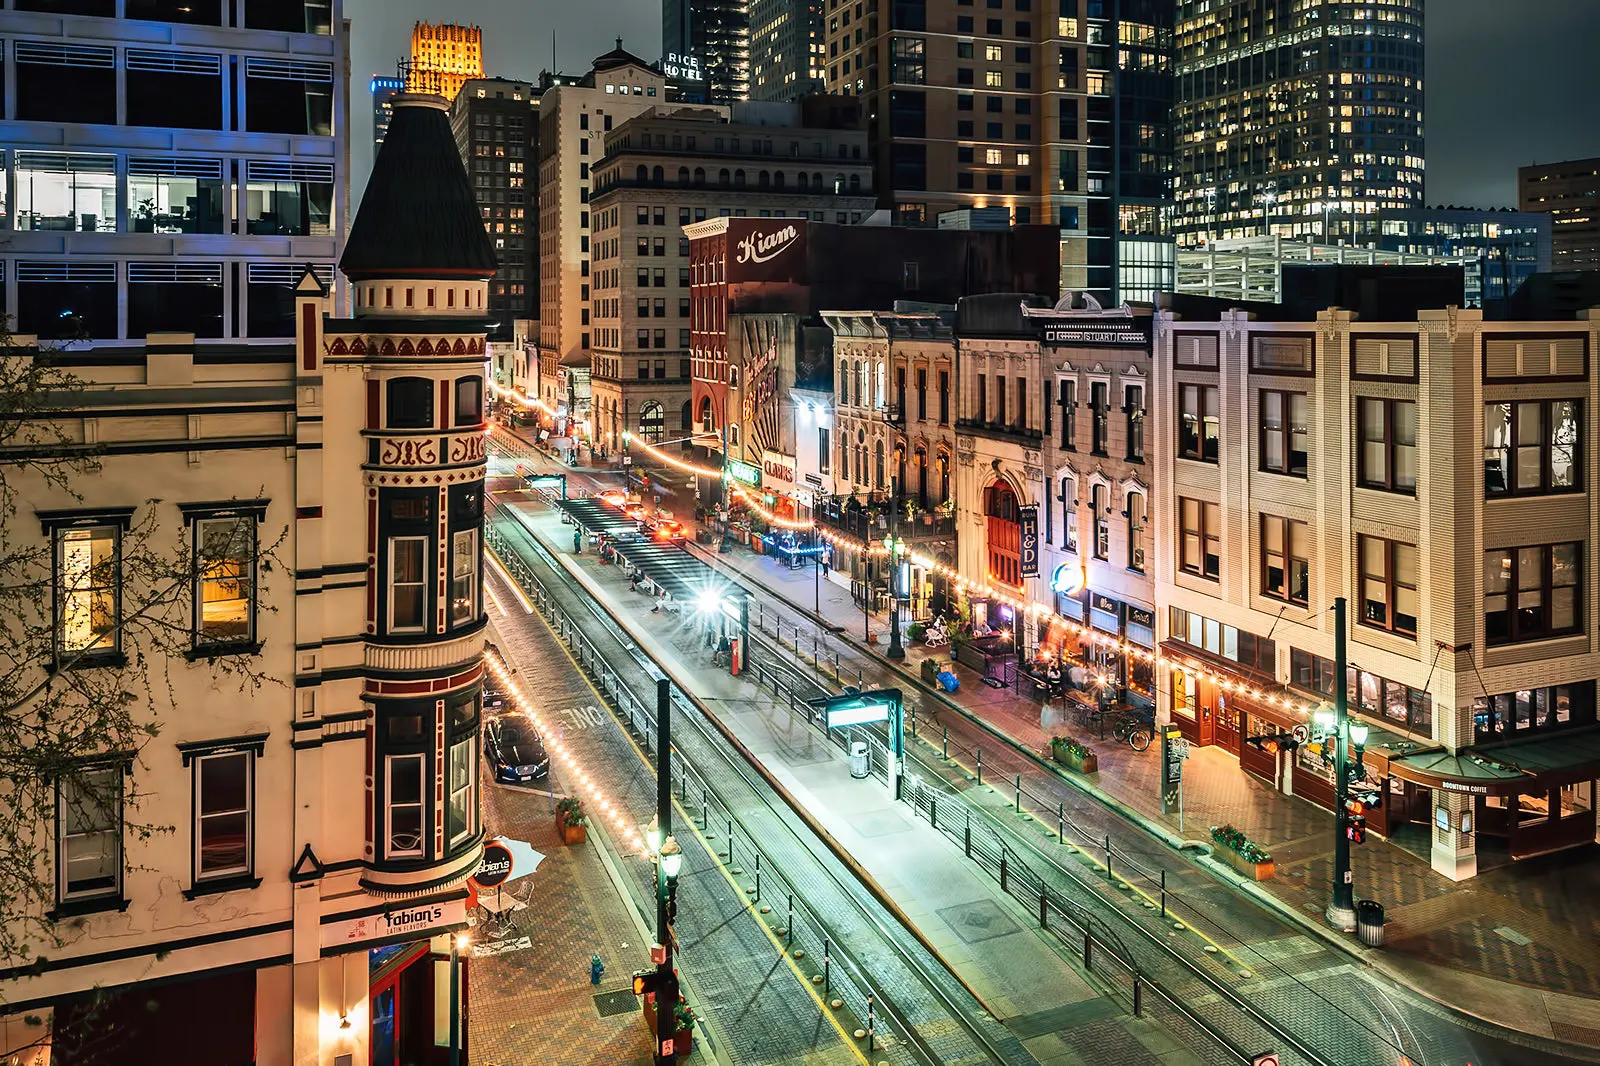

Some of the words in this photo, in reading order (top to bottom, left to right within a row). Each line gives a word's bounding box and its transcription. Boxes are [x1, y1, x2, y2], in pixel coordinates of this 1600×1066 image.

[668, 52, 698, 67] RICE
[663, 62, 703, 81] HOTEL
[736, 225, 800, 264] Kiam
[1084, 332, 1115, 342] STUART
[764, 460, 793, 483] CLARKS
[1442, 781, 1470, 791] BOOMTOWN
[1470, 785, 1488, 793] COFFEE
[386, 927, 402, 935] LATIN
[403, 922, 427, 932] FLAVORS
